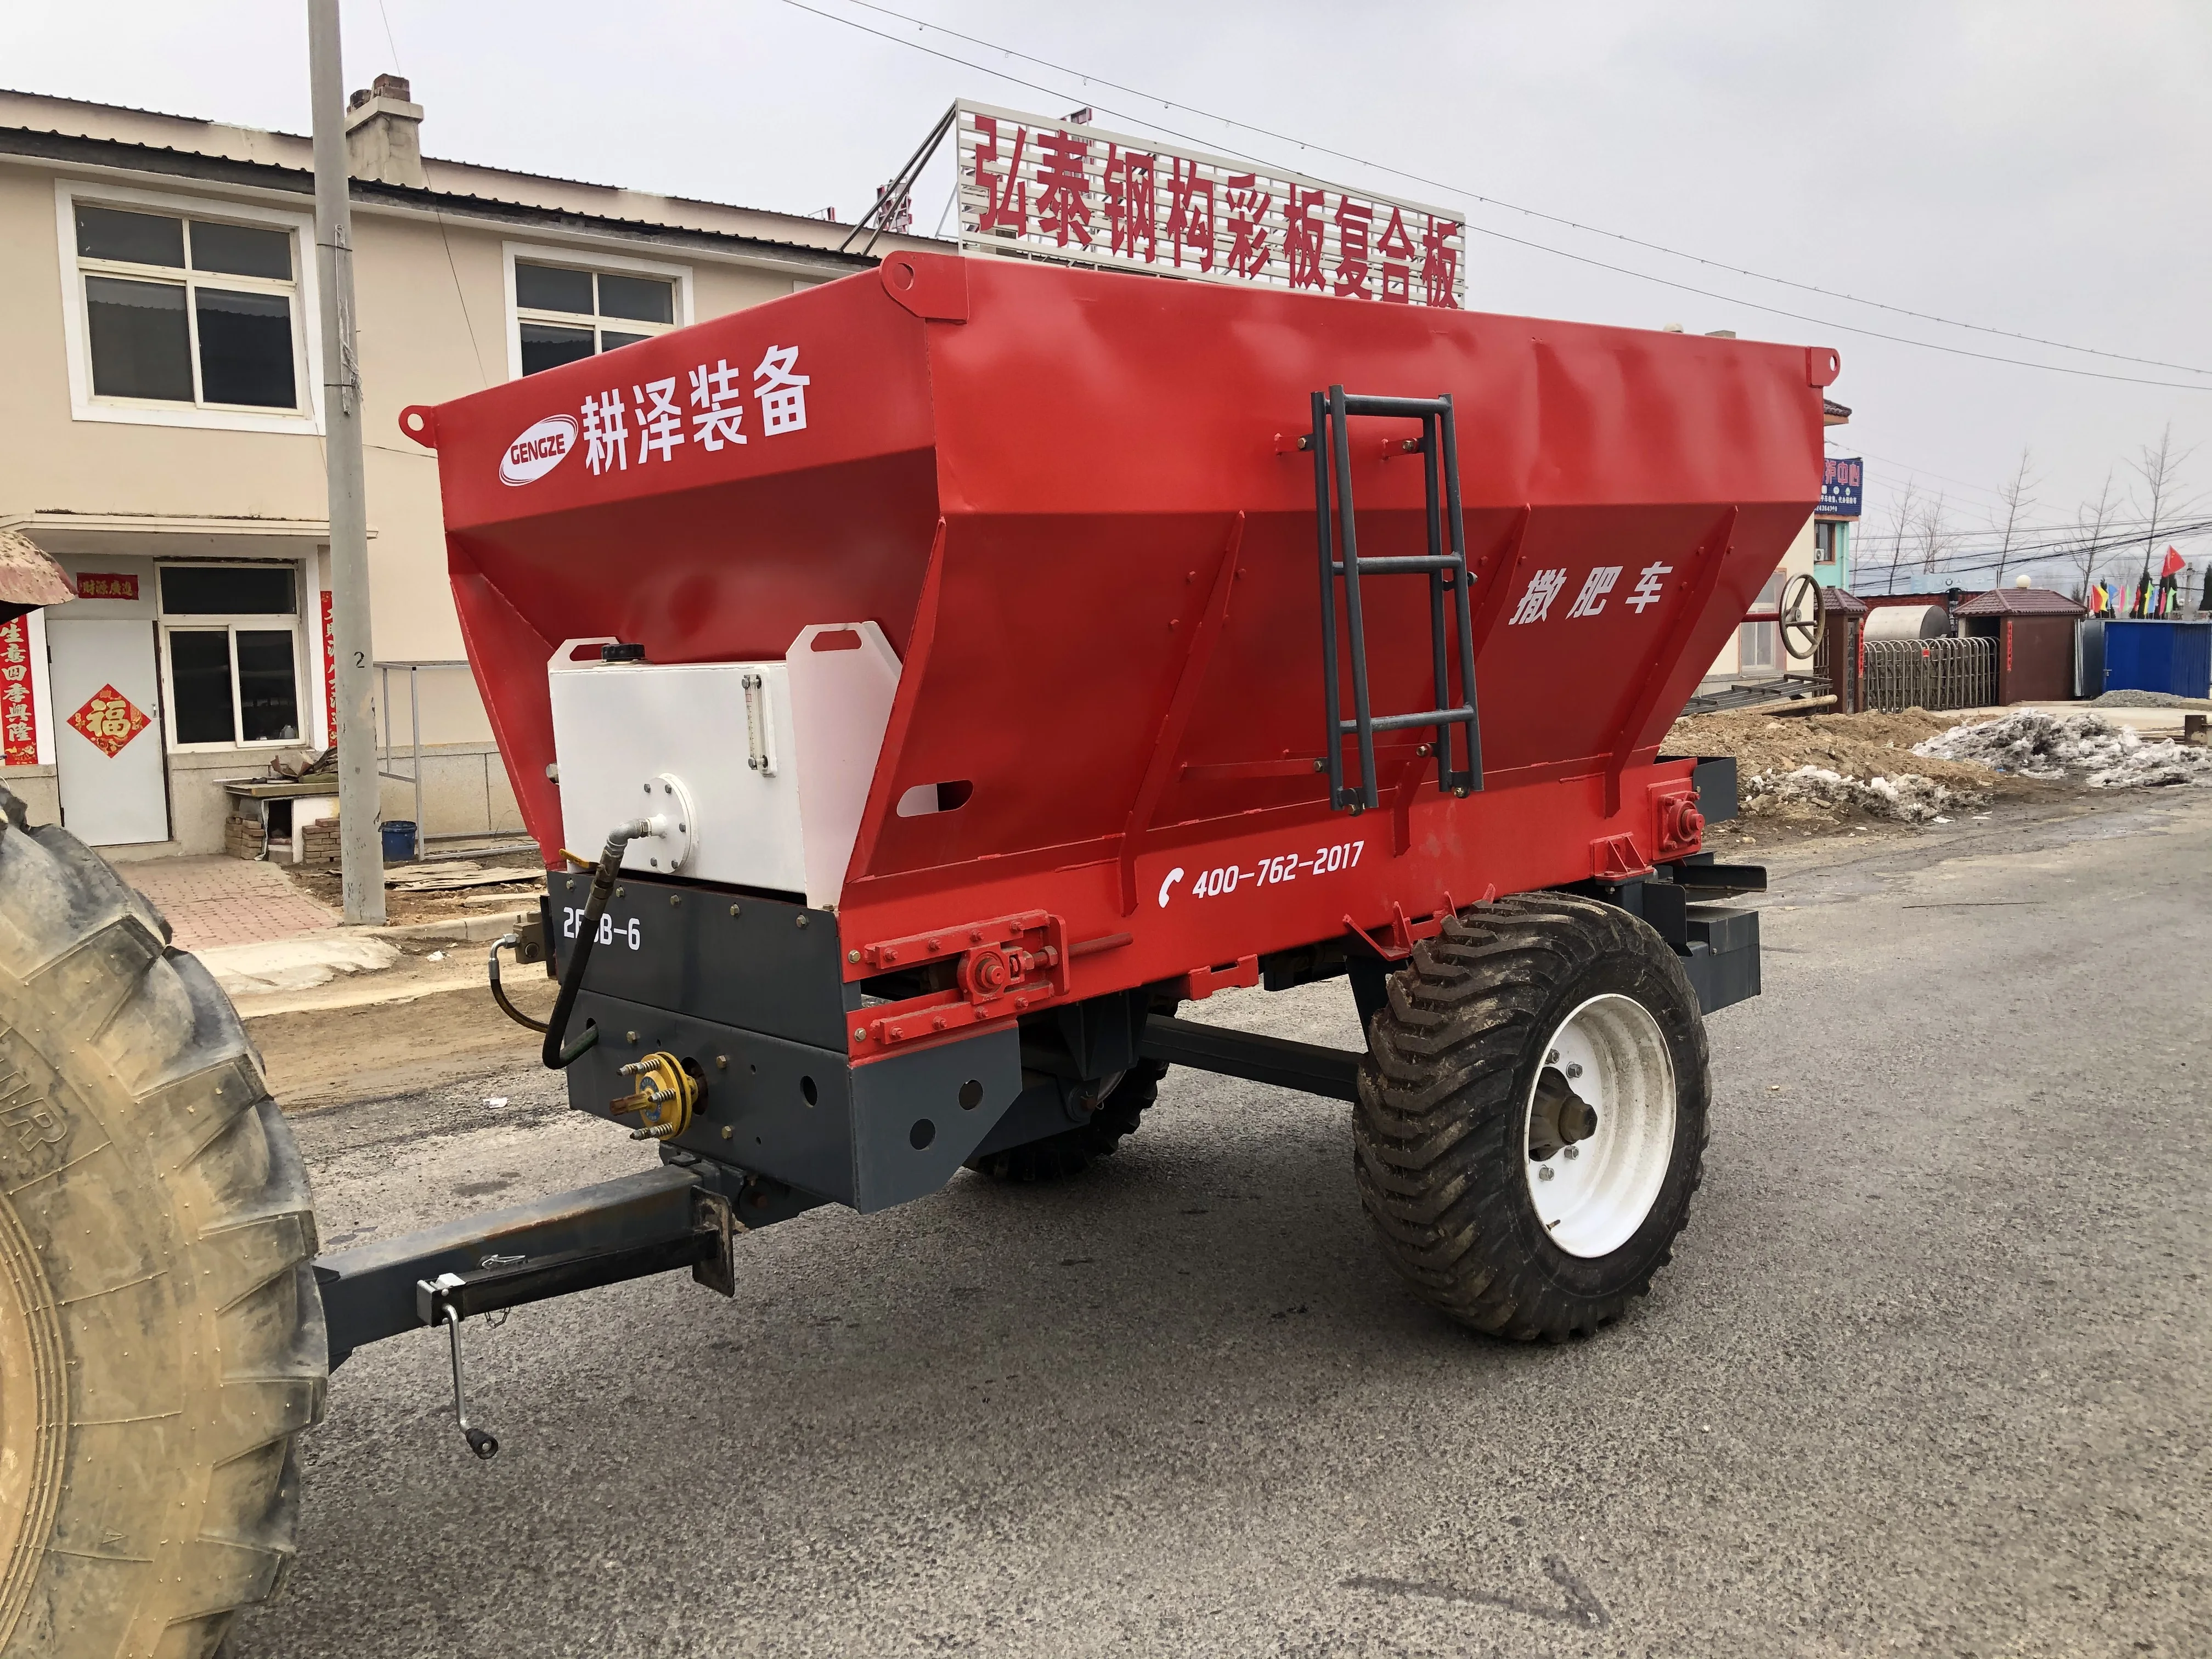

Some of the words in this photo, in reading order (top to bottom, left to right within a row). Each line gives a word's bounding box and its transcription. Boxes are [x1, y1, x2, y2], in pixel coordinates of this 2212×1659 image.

[974, 114, 1459, 309] 弘泰钢构彩板复合板
[580, 344, 810, 476] 耕泽装备
[510, 432, 566, 465] GENGZE
[1508, 561, 1674, 625] 撒肥车
[0, 617, 33, 742] 生意四季興隆
[353, 651, 365, 668] 2
[86, 698, 131, 738] 福
[1192, 840, 1365, 899] 400-762-2017
[563, 906, 641, 951] 2FB-6
